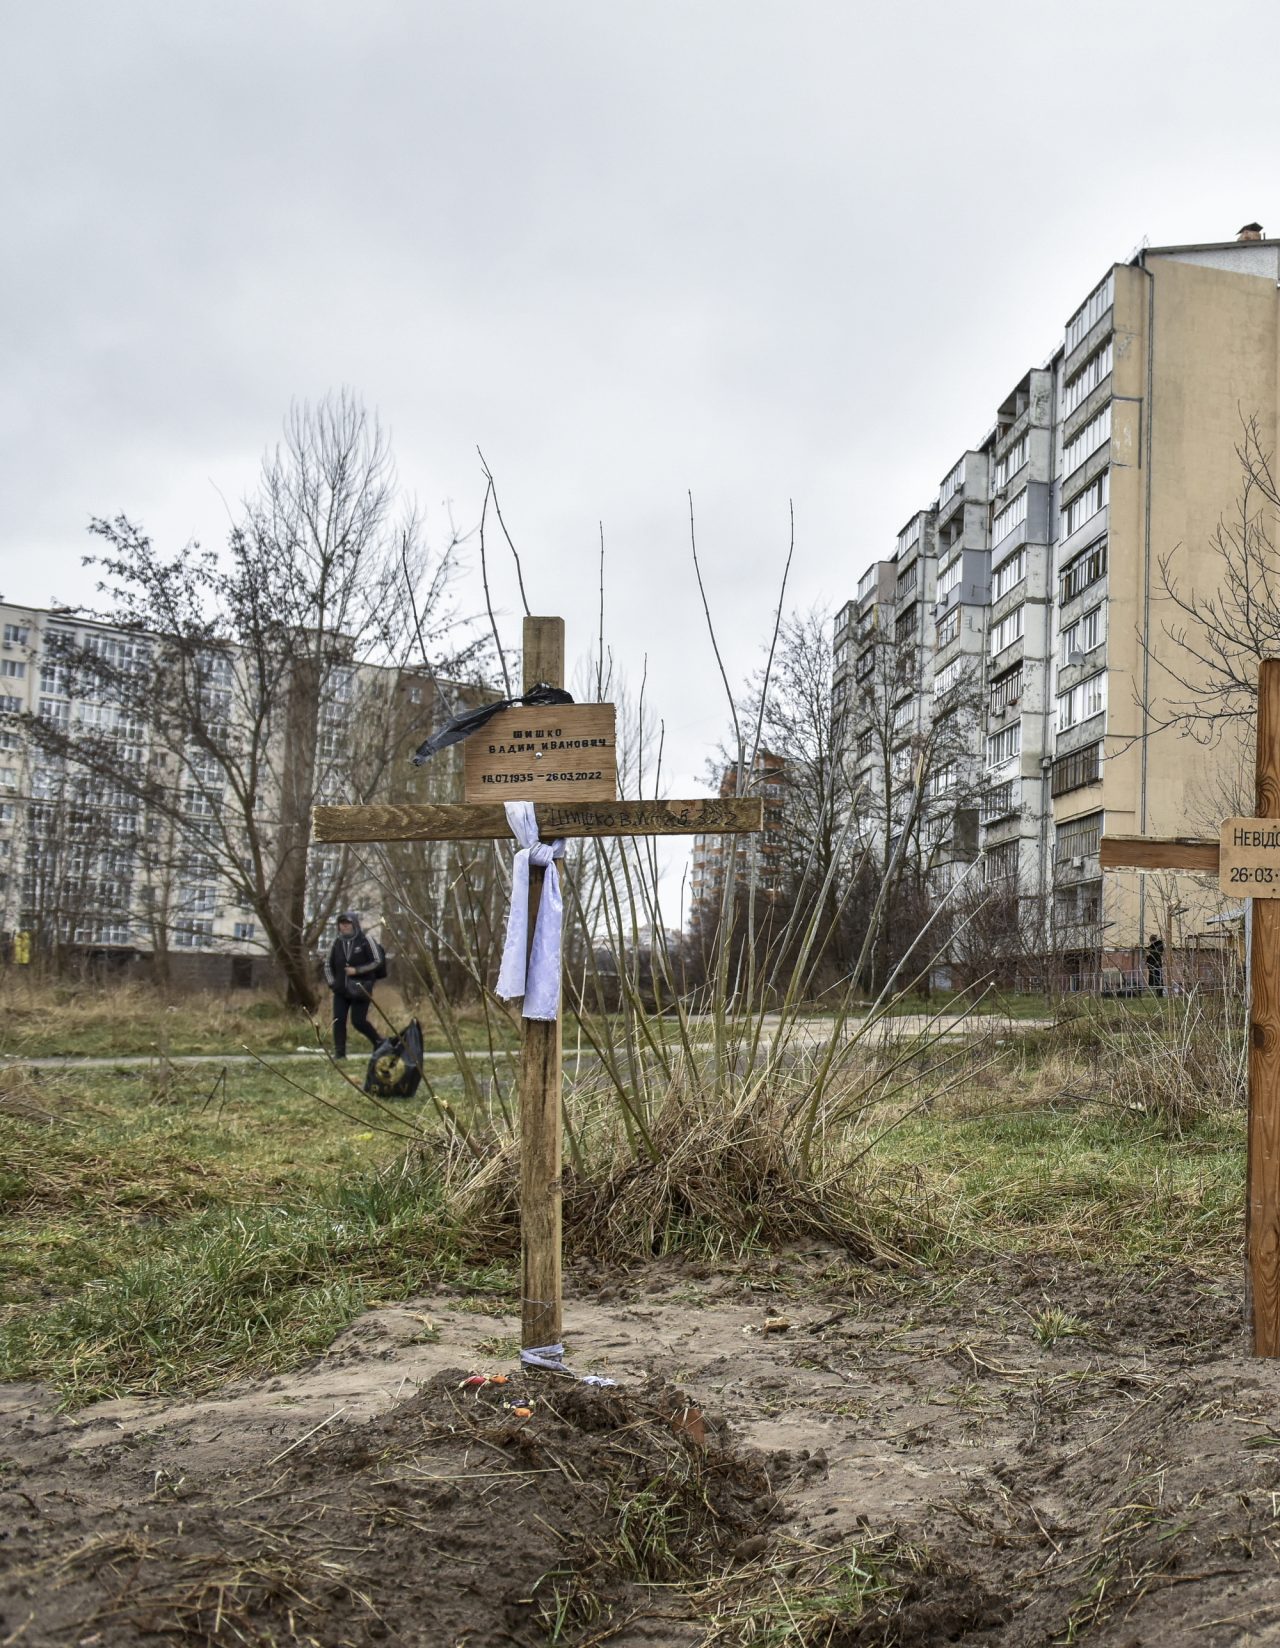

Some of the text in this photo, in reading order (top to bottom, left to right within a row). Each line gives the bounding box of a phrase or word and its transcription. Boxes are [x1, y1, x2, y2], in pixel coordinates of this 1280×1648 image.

[513, 728, 562, 739] ШИШКО
[488, 738, 606, 754] ВАДИМ ИВАНОВИЧ
